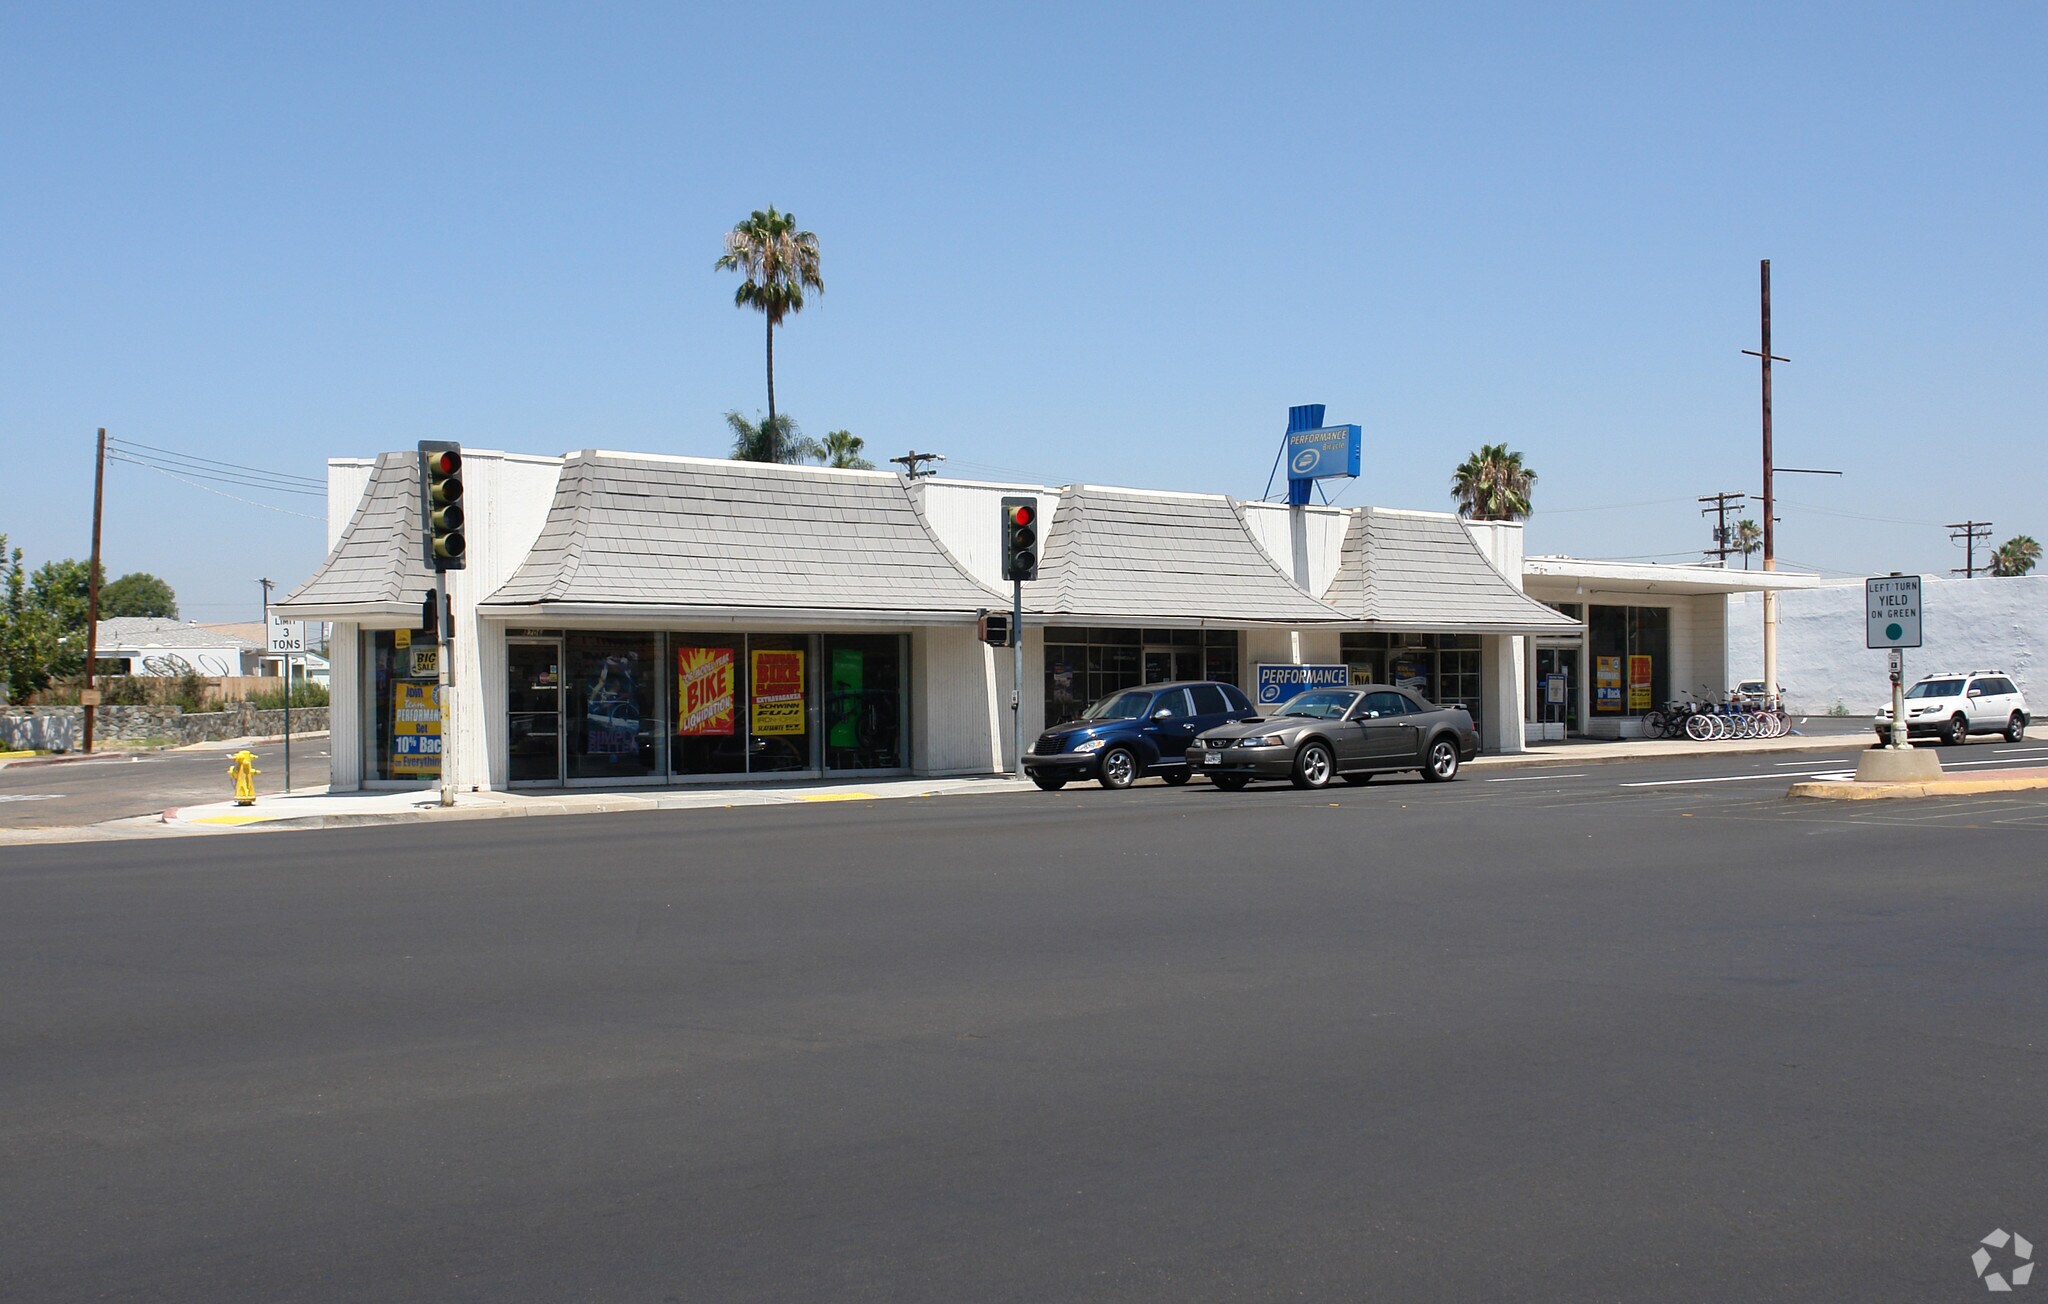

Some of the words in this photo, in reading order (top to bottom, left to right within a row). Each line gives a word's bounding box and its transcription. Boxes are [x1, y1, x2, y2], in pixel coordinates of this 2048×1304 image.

[1290, 430, 1347, 445] PERFORMANCE
[1869, 583, 1890, 593] LEFT
[1895, 582, 1917, 591] TURN
[1879, 595, 1908, 606] YIELD
[1871, 611, 1883, 619] ON
[1887, 609, 1916, 618] GREEN
[283, 627, 290, 637] 3
[272, 640, 301, 649] TONS
[416, 653, 436, 663] BIG
[417, 663, 436, 671] SALE
[757, 664, 801, 682] BIKE
[1261, 669, 1346, 684] PERFORMANCE
[687, 666, 727, 714] BIKE
[683, 696, 732, 731] LIQUIDATION
[396, 736, 417, 753] 10%
